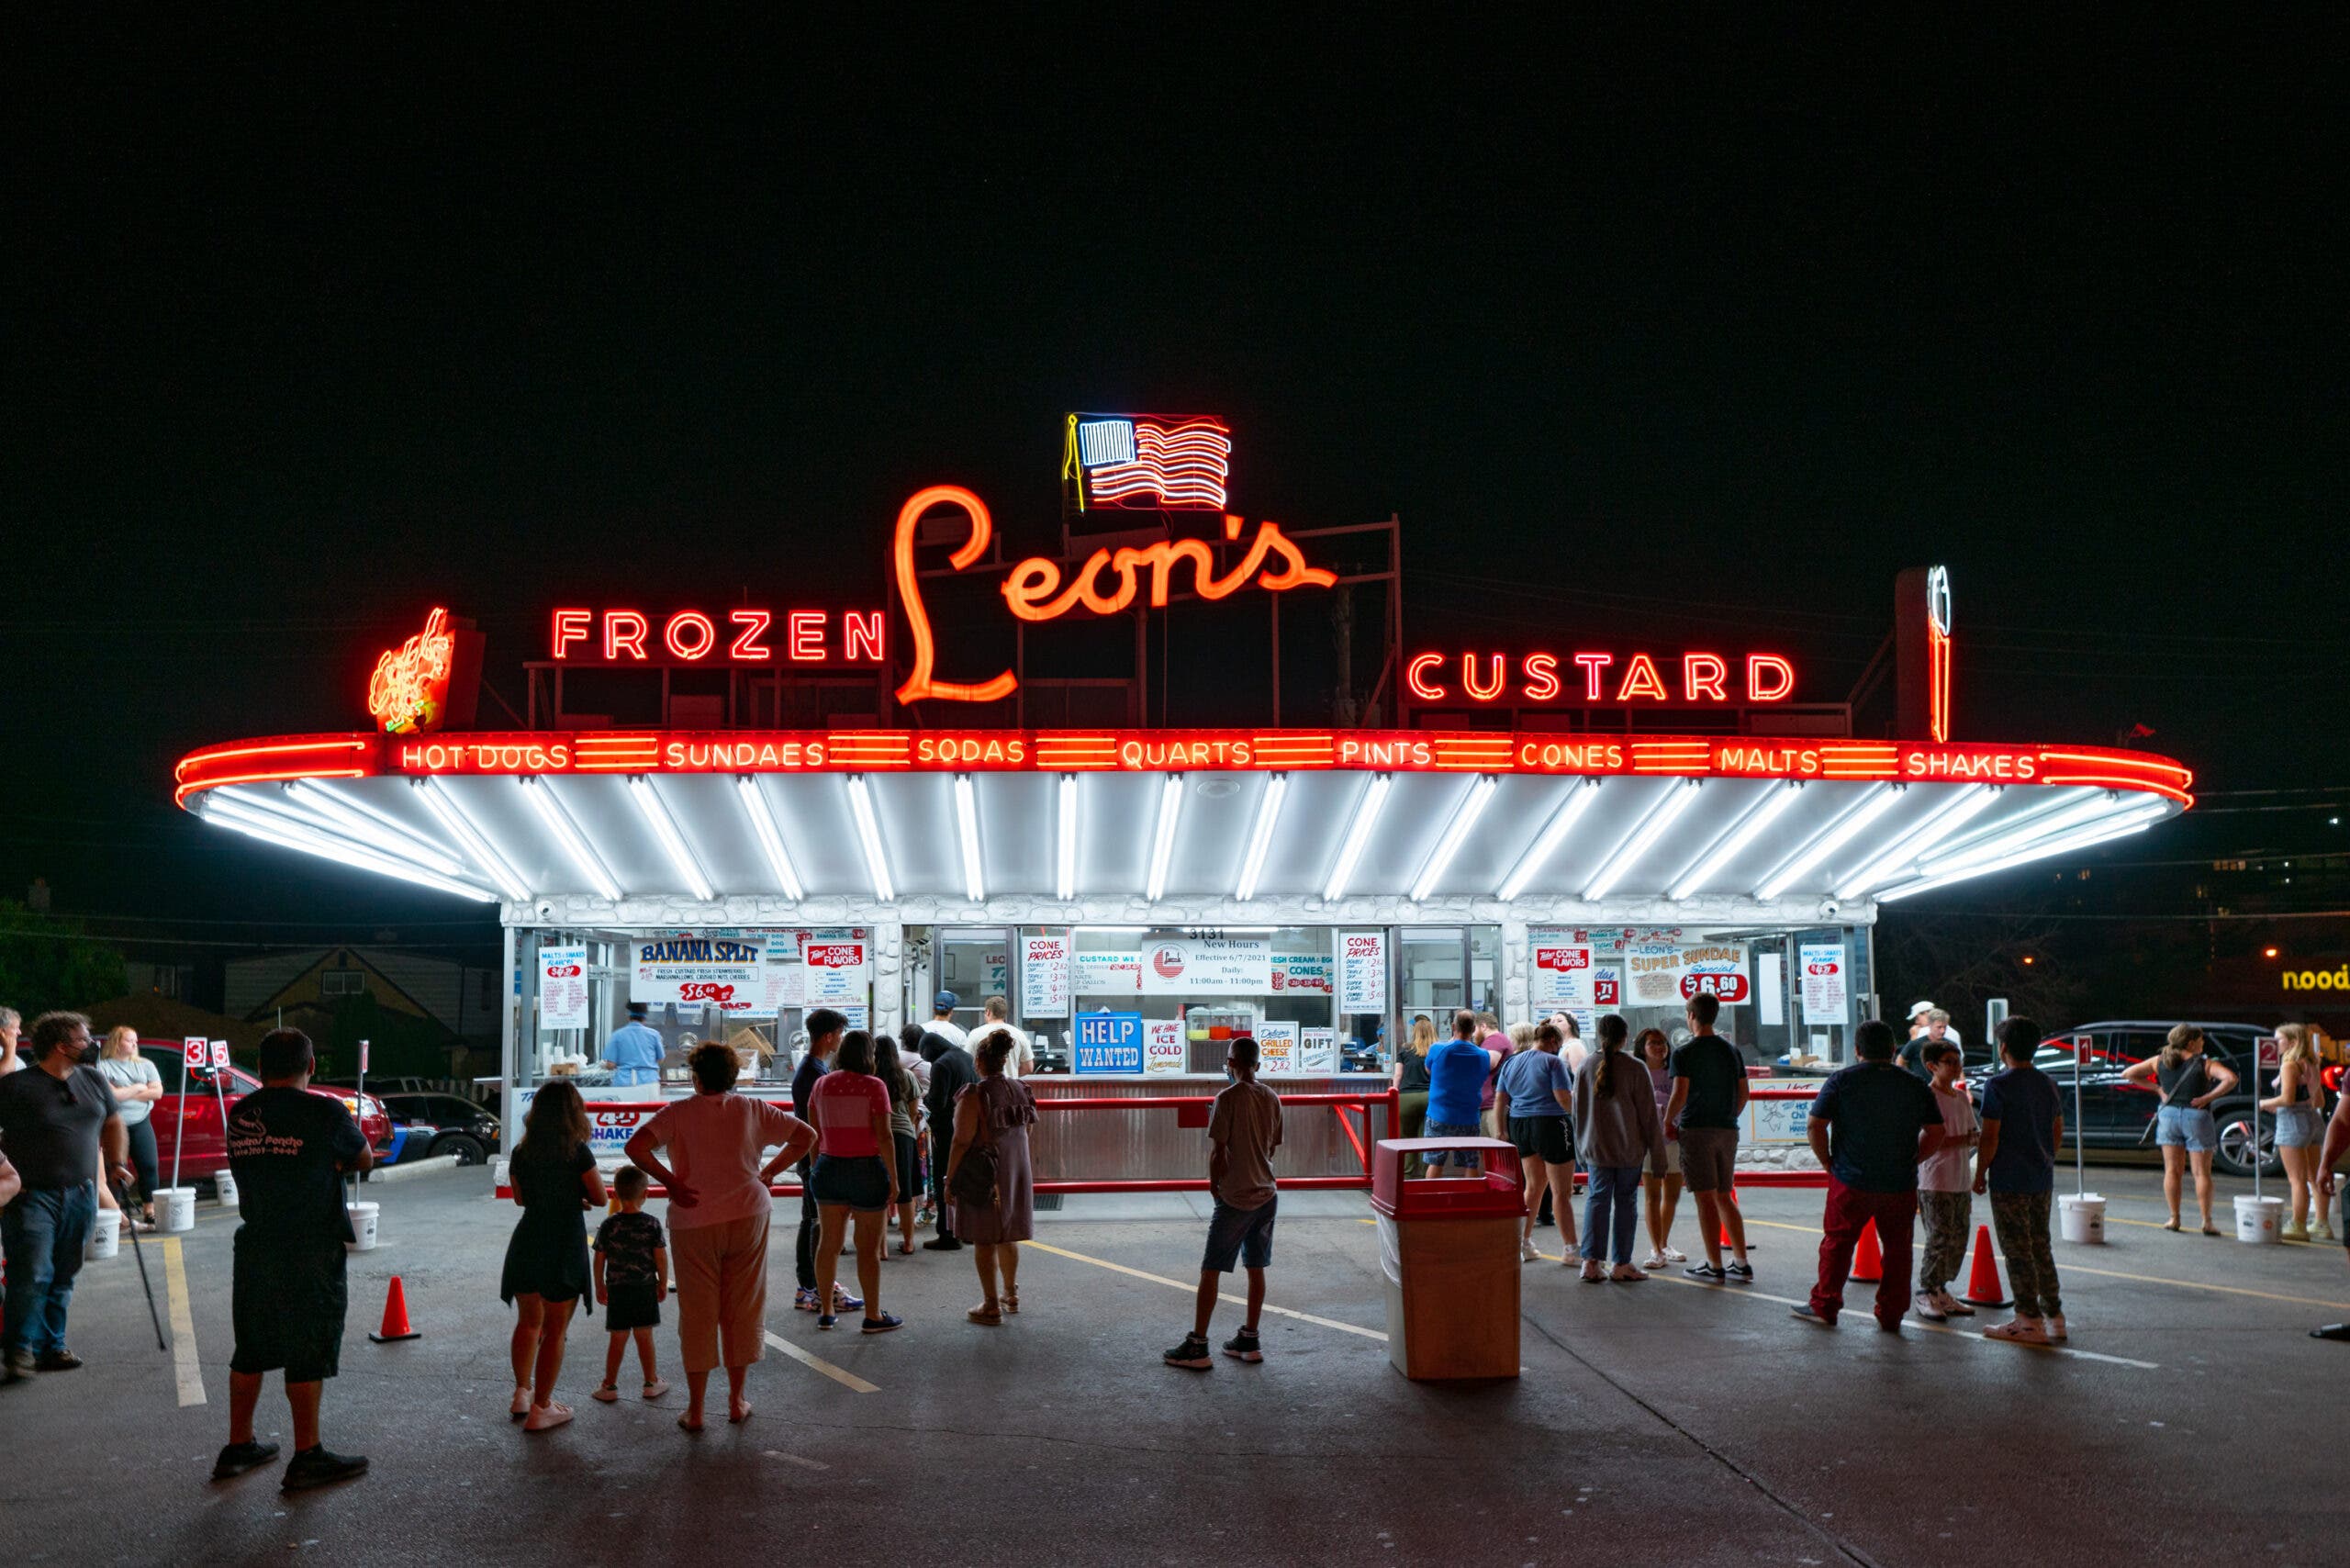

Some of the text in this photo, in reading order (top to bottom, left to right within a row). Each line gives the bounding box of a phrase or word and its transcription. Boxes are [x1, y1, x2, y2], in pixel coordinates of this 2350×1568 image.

[894, 485, 1338, 705] Leon's
[553, 609, 885, 660] FROZEN
[1407, 652, 1795, 700] CUSTARD
[666, 742, 824, 767] SUNDAES
[917, 738, 1024, 763] SODAS
[1122, 741, 1250, 769] QUARTS
[1341, 741, 1431, 765] PINTS
[1521, 743, 1623, 767] CONES
[402, 745, 569, 769] HOT DOGS
[1720, 747, 1818, 774] MALTS
[1907, 752, 2035, 778] SHAKES
[1189, 927, 1225, 940] 3131
[1029, 941, 1060, 950] CONE
[1203, 940, 1259, 949] New Hours
[1347, 937, 1378, 946] CONE
[640, 939, 758, 963] BANANA SPLIT
[827, 946, 855, 956] CONE
[1027, 949, 1064, 961] PRICES
[1346, 946, 1381, 958] PRICES
[1556, 949, 1581, 958] CONE
[1639, 944, 1674, 955] LEON'S
[823, 956, 860, 965] FLAVORS
[1195, 953, 1267, 962] Effective 6/7/2021
[1288, 956, 1315, 964] CREAM
[1552, 958, 1585, 967] FLAVORS
[1631, 946, 1741, 971] SUPER SUNDAE
[1221, 966, 1243, 975] Daily:
[1289, 966, 1324, 976] CONES
[1689, 963, 1736, 974] Special
[1190, 977, 1224, 985] 11:00am
[1230, 977, 1264, 986] 11:00pm
[1685, 974, 1738, 994] $6.60
[1080, 1021, 1135, 1044] HELP
[1151, 1023, 1181, 1035] WE HAVE
[1156, 1035, 1176, 1044] ICE
[1260, 1038, 1293, 1047] GRILLED
[1304, 1038, 1333, 1048] GIFT
[187, 1041, 204, 1063] 3
[213, 1042, 227, 1063] 5
[1149, 1046, 1182, 1055] COLD
[1260, 1047, 1289, 1056] CHEESE
[2261, 1041, 2277, 1064] 2
[1079, 1047, 1139, 1067] WANTED
